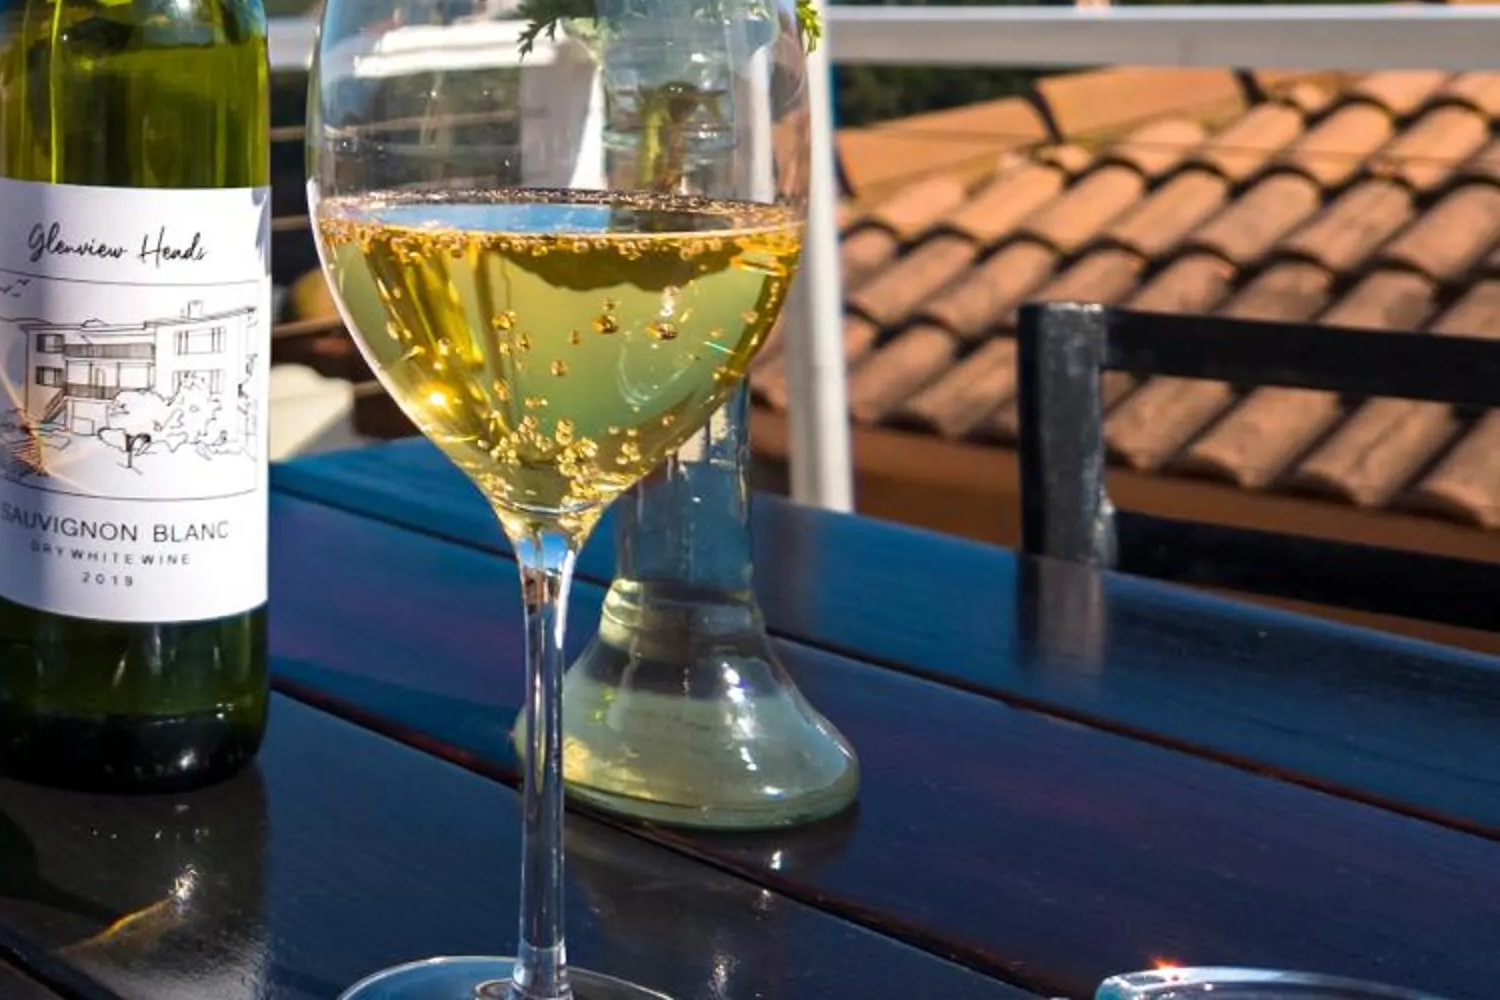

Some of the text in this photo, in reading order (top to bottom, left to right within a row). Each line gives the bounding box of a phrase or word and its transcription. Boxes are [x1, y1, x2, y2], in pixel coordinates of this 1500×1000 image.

[27, 220, 128, 264] Glenview
[0, 502, 230, 543] SAUVIGNON BLANC
[30, 538, 192, 566] DRY WHITE WINE
[81, 570, 134, 588] 2019
